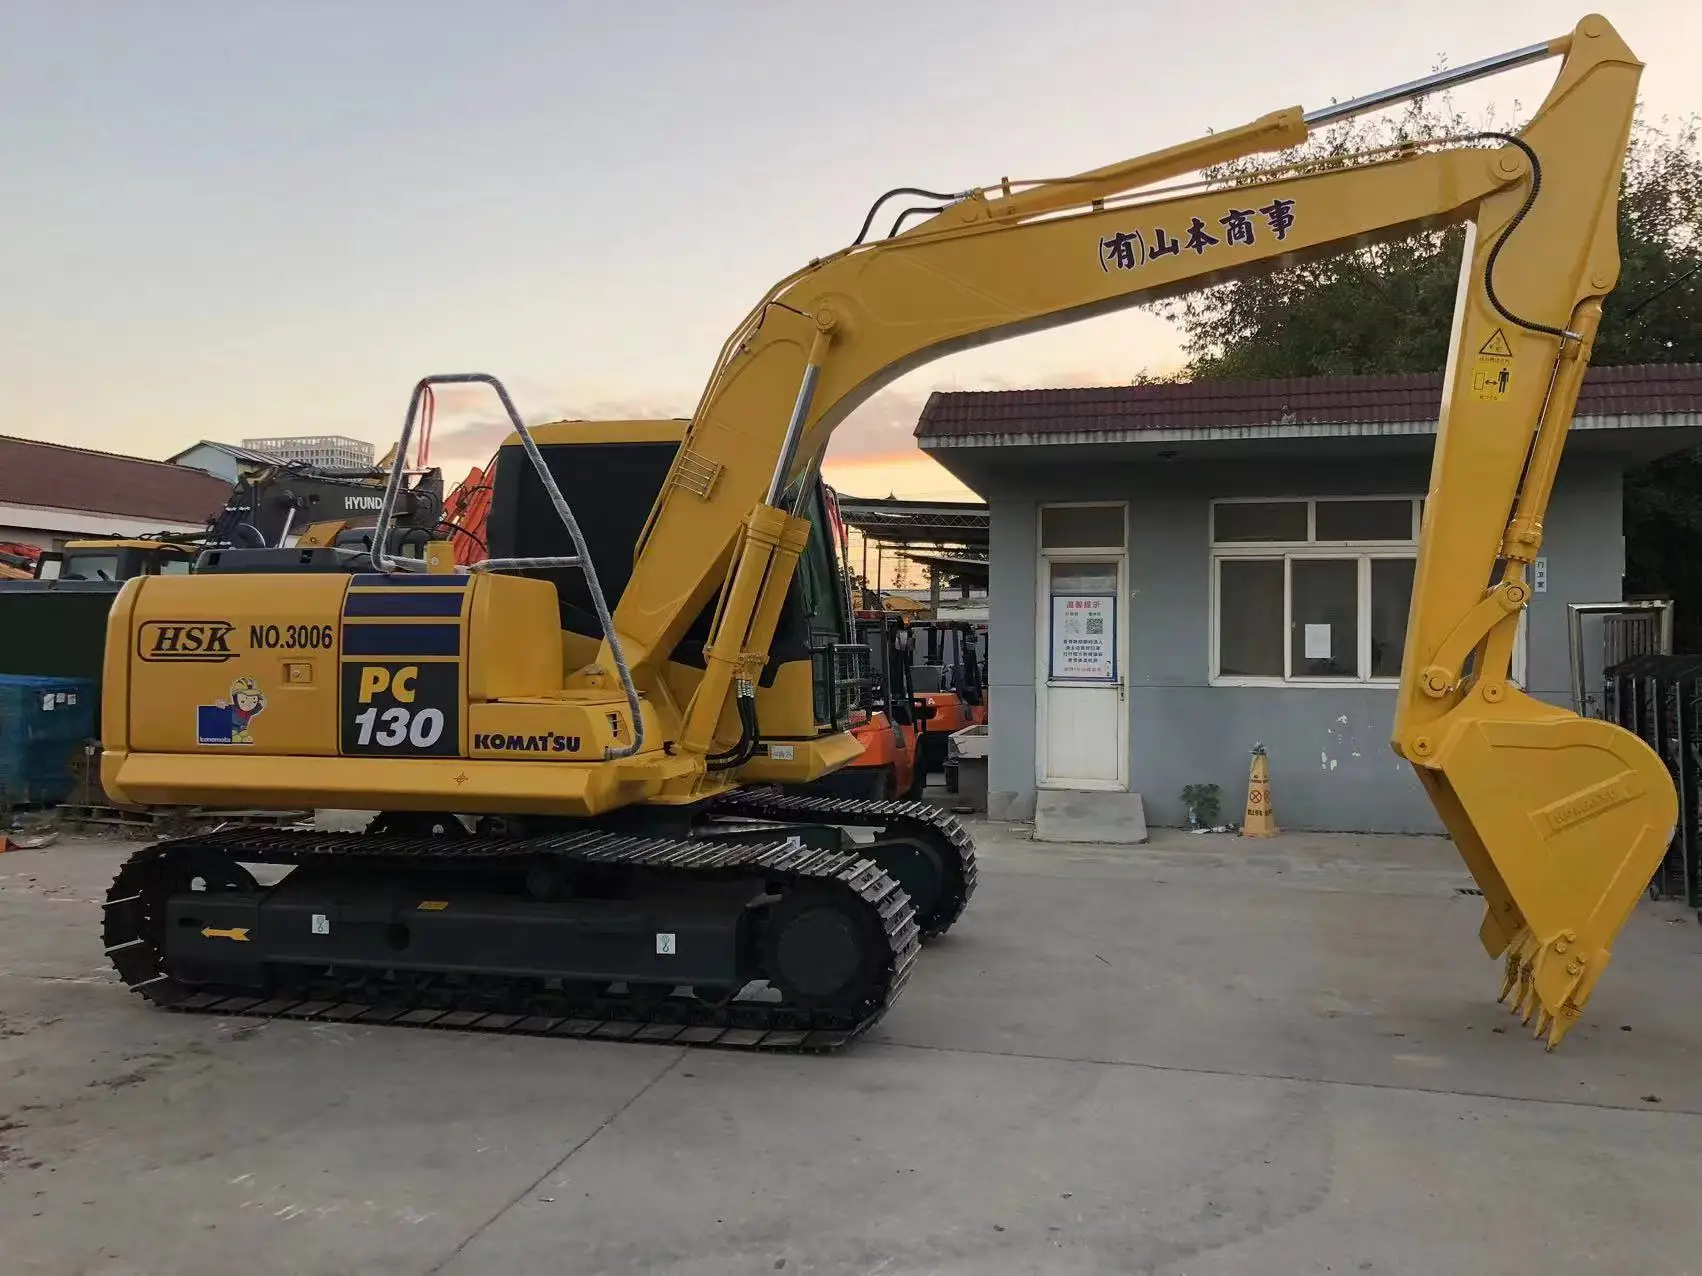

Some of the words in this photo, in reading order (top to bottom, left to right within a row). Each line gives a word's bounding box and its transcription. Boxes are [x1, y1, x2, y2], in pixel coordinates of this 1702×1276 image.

[1099, 198, 1296, 273] (有)山本商事
[344, 496, 383, 510] HYUND
[151, 625, 237, 653] HSK
[249, 624, 333, 651] NO.3006
[358, 665, 419, 705] PC
[354, 707, 445, 749] 130
[474, 731, 581, 752] KOMATSU
